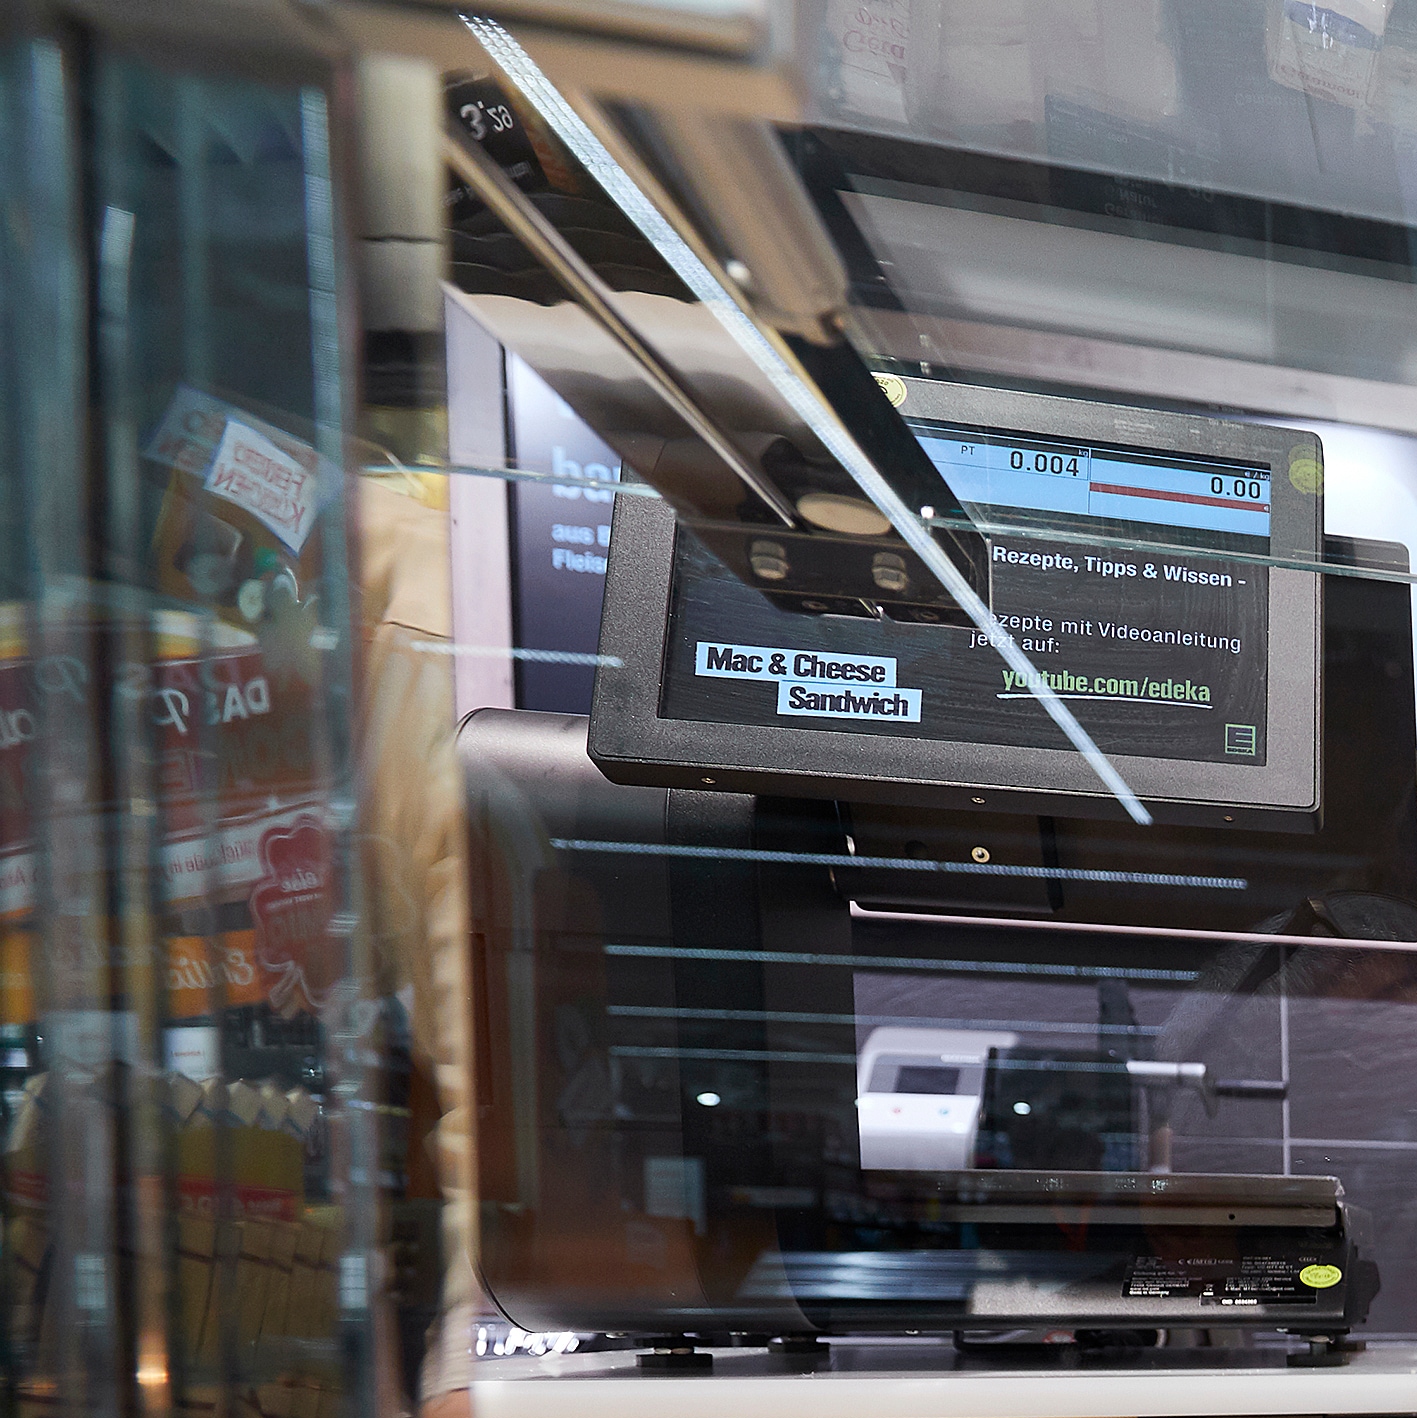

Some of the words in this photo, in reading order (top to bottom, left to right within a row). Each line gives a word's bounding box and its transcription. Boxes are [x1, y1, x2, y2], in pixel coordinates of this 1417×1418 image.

[961, 445, 975, 455] PT
[1010, 449, 1079, 476] 0.004
[1210, 476, 1261, 499] 0.00
[993, 546, 1079, 573] Rezepte,
[1084, 556, 1137, 578] Tipps
[1143, 564, 1158, 578] &
[1163, 565, 1232, 588] Wissen
[1022, 638, 1060, 654] auf:
[1061, 620, 1092, 637] mit
[1099, 622, 1241, 654] Videoanleitung
[707, 646, 763, 673] Mac
[768, 653, 788, 675] &
[794, 654, 886, 682] Cheese
[1002, 669, 1211, 702] youtube.com/edeka
[789, 686, 908, 717] Sandwich
